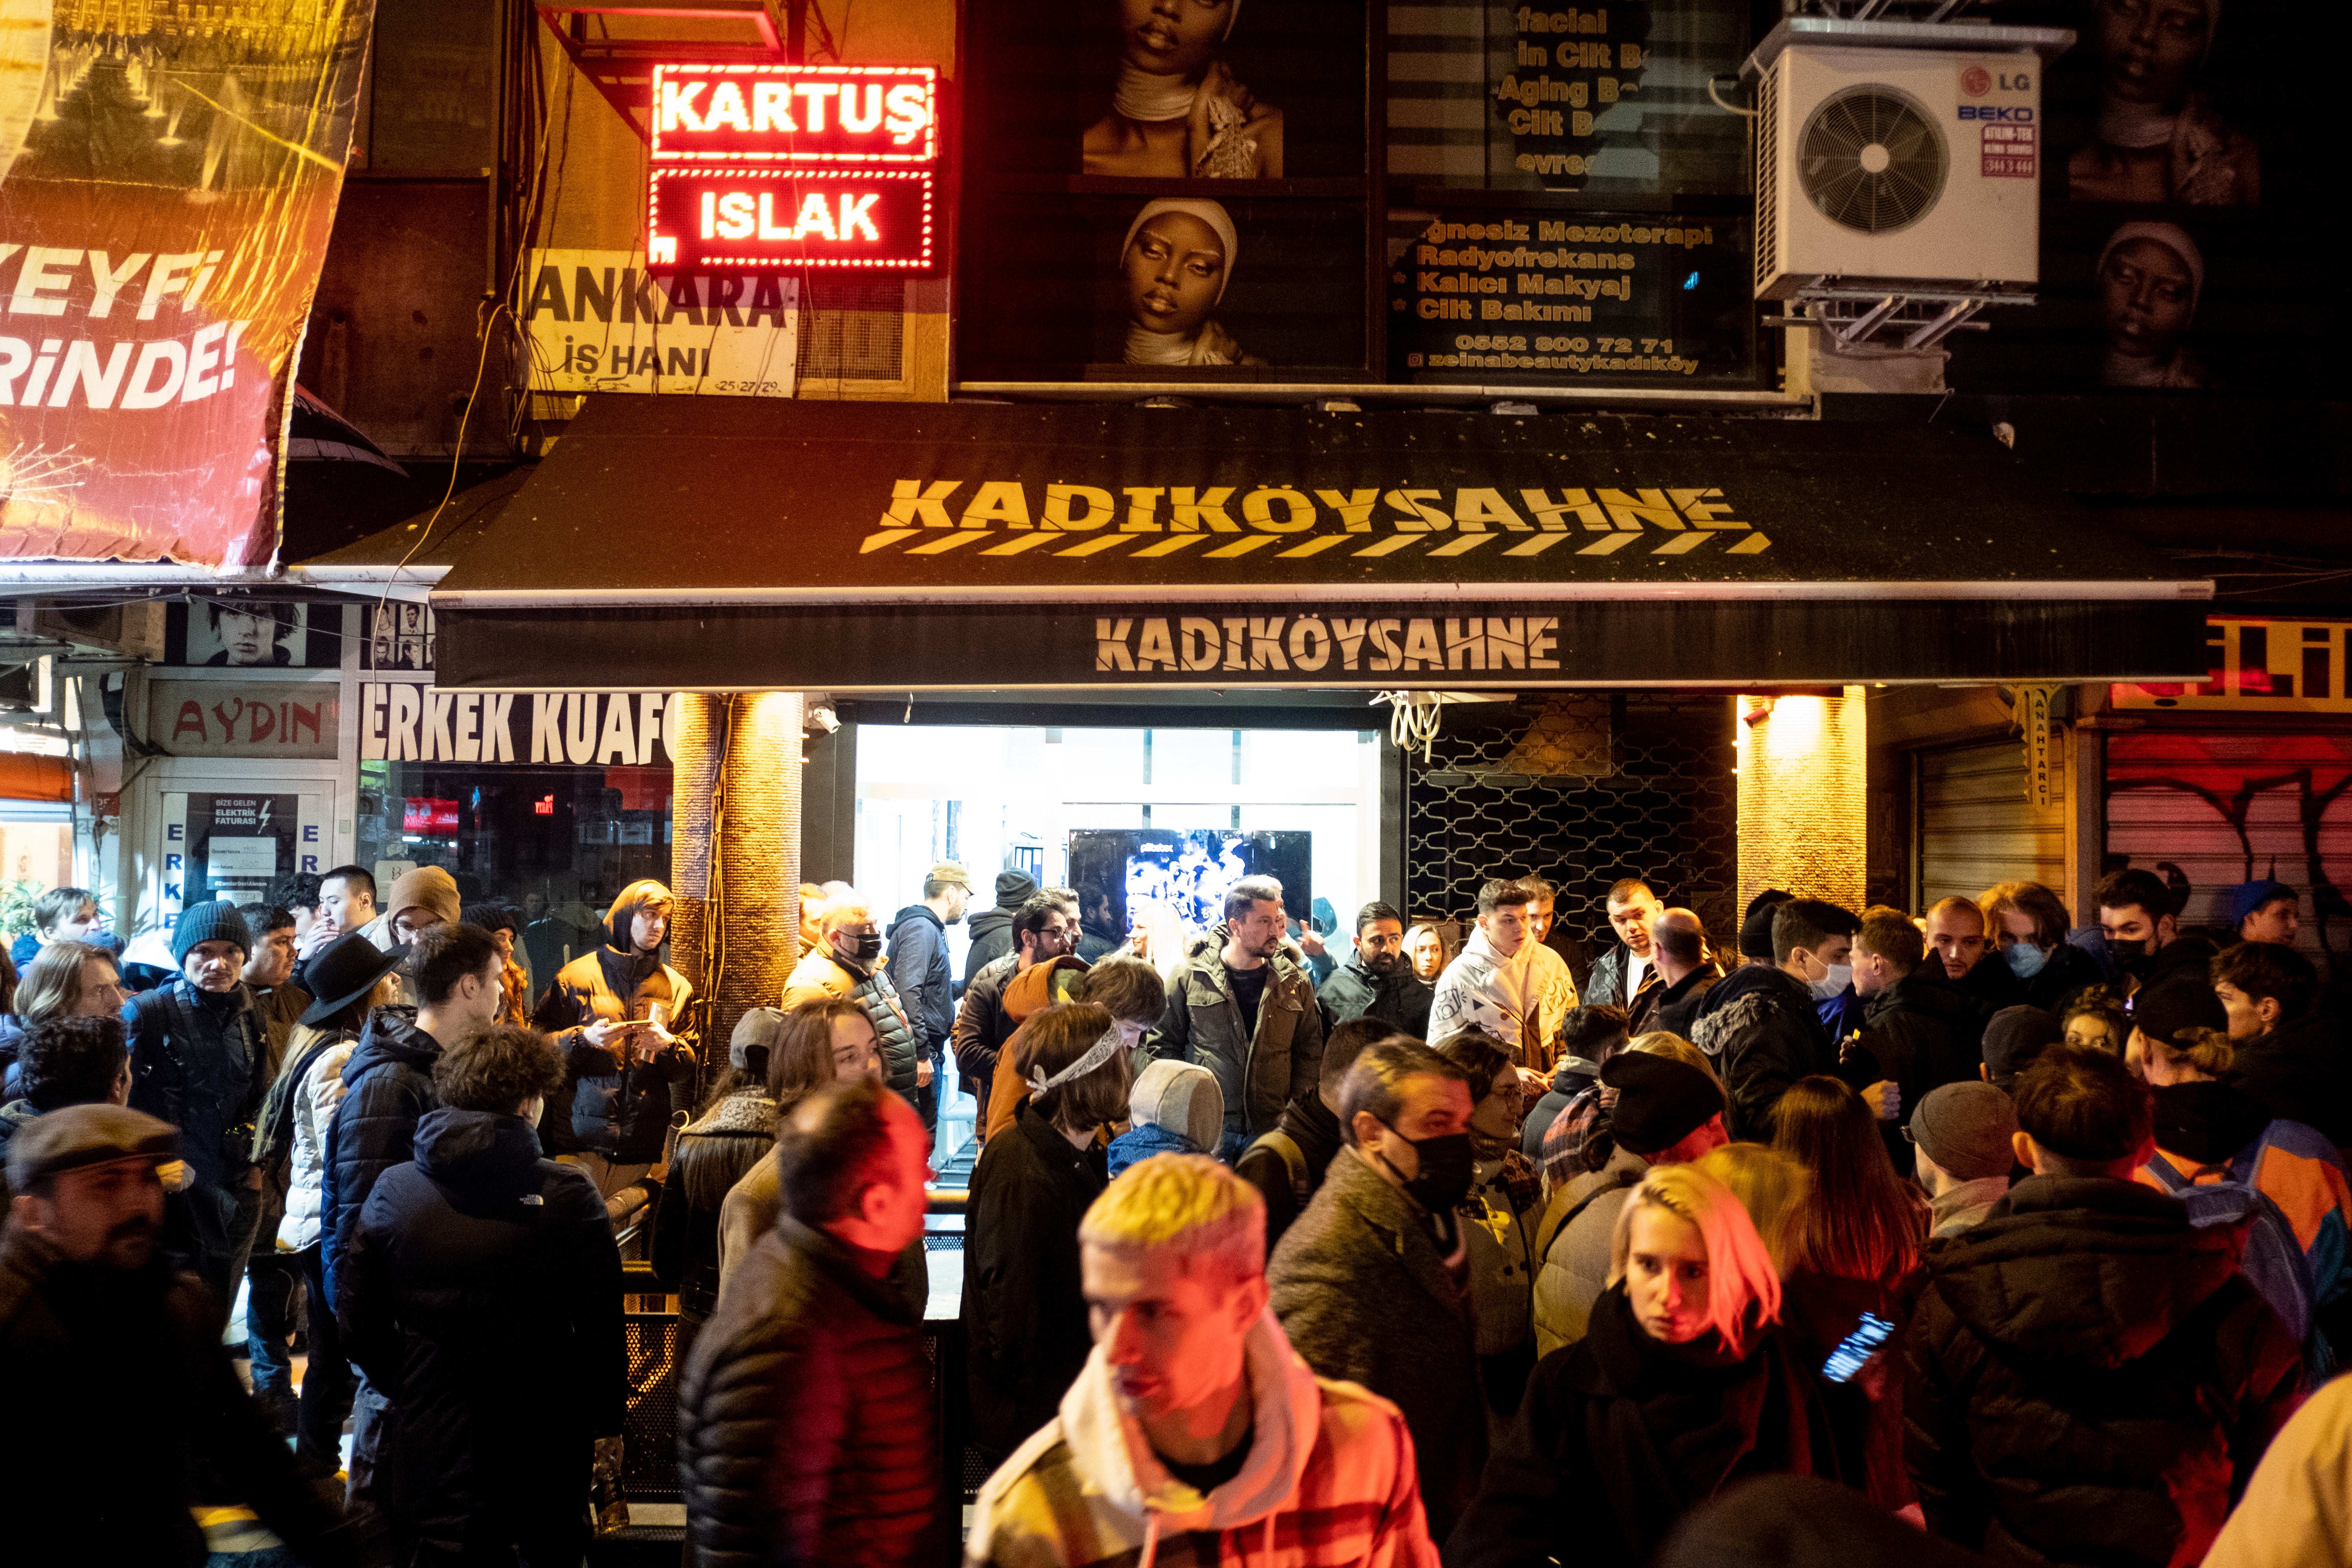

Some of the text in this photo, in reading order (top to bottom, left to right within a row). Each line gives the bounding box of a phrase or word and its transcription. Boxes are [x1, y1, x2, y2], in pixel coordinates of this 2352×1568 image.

[1557, 42, 1611, 68] Cilt
[2000, 73, 2031, 91] LG
[662, 82, 926, 144] KARTUŞ
[1958, 105, 2033, 122] BEKO
[701, 192, 880, 241] ISLAK
[1539, 220, 1713, 249] Mezoterapi
[1417, 245, 1635, 270] Radyofrekans
[529, 265, 787, 328] ANKARA
[1417, 272, 1631, 301] Kalıcı Makyaj
[1417, 298, 1592, 322] Cilt Bakımı
[1455, 335, 1672, 354] 0552 800 72 71
[611, 345, 710, 377] HANI
[879, 479, 1753, 532] KADIKÖYSAHNE
[1096, 613, 1560, 671] KADIKÖYSAHNE
[172, 697, 321, 743] AYDIN
[361, 683, 515, 762] ERKEK
[2035, 699, 2046, 805] ANAHTARCI
[216, 808, 255, 816] ELEKTRİK
